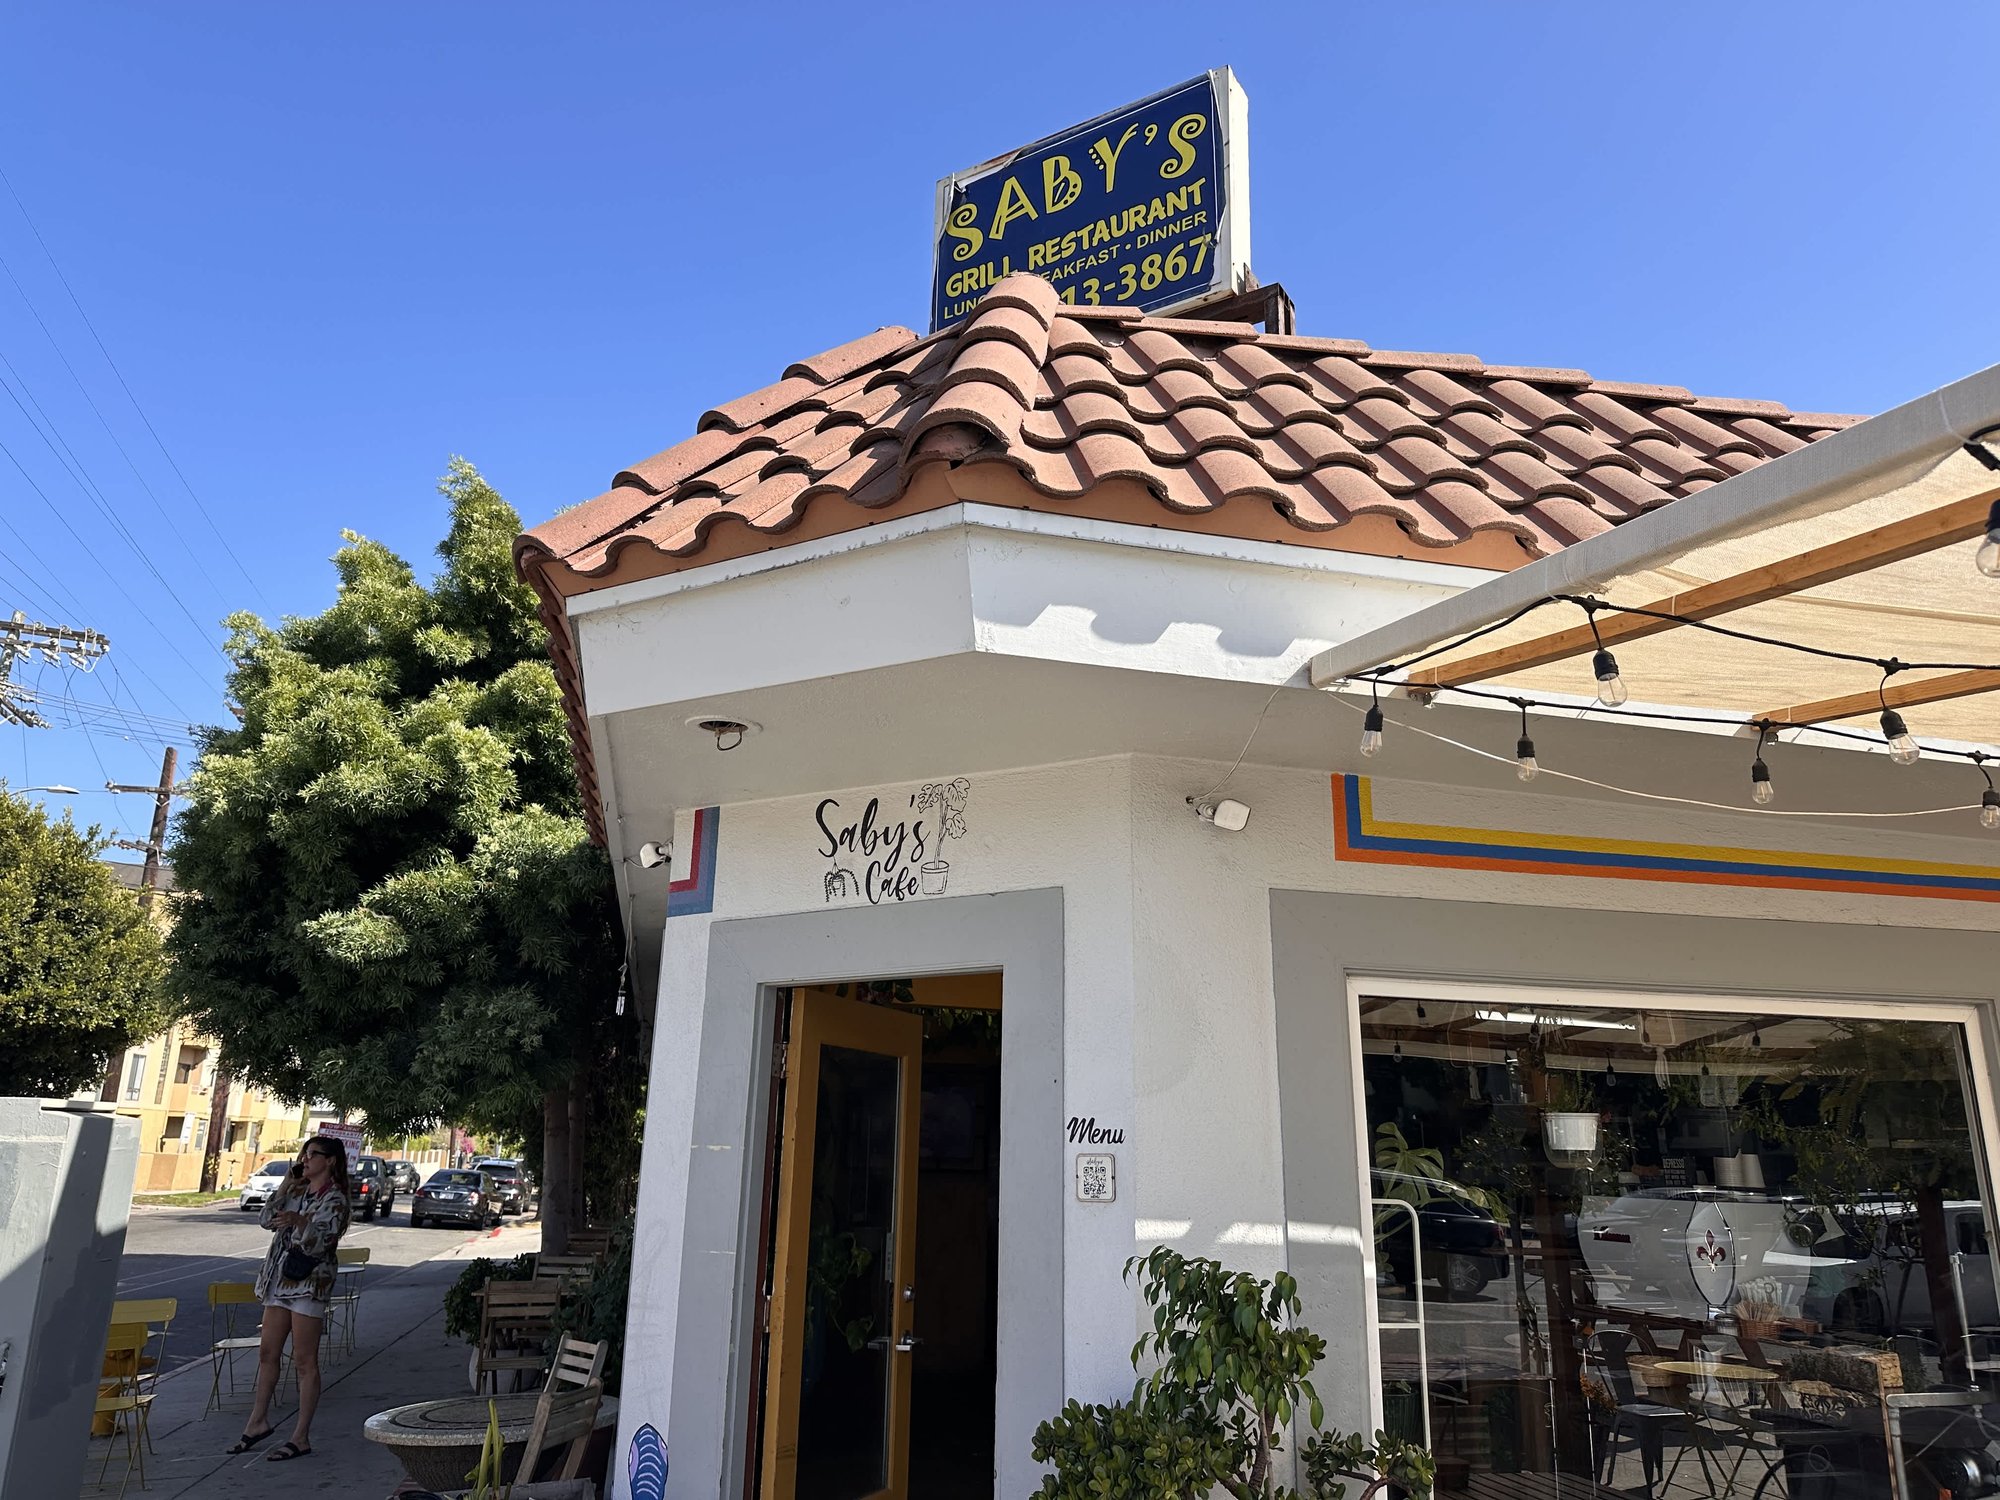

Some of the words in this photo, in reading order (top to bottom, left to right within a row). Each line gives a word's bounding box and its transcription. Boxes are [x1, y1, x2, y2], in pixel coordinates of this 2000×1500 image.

[945, 113, 1207, 262] SABY'S
[944, 295, 986, 320] LUN
[1041, 244, 1121, 283] EAKFAST
[1136, 210, 1208, 250] DINNER
[945, 256, 1017, 298] GRILL
[1028, 178, 1207, 271] RESTAURANT
[1060, 232, 1213, 306] 13-3867
[815, 794, 931, 872] Saby's
[865, 860, 920, 904] Cafe
[344, 1139, 361, 1150] KING
[1066, 1116, 1127, 1145] Menu
[1662, 1158, 1685, 1169] DEPRESSO
